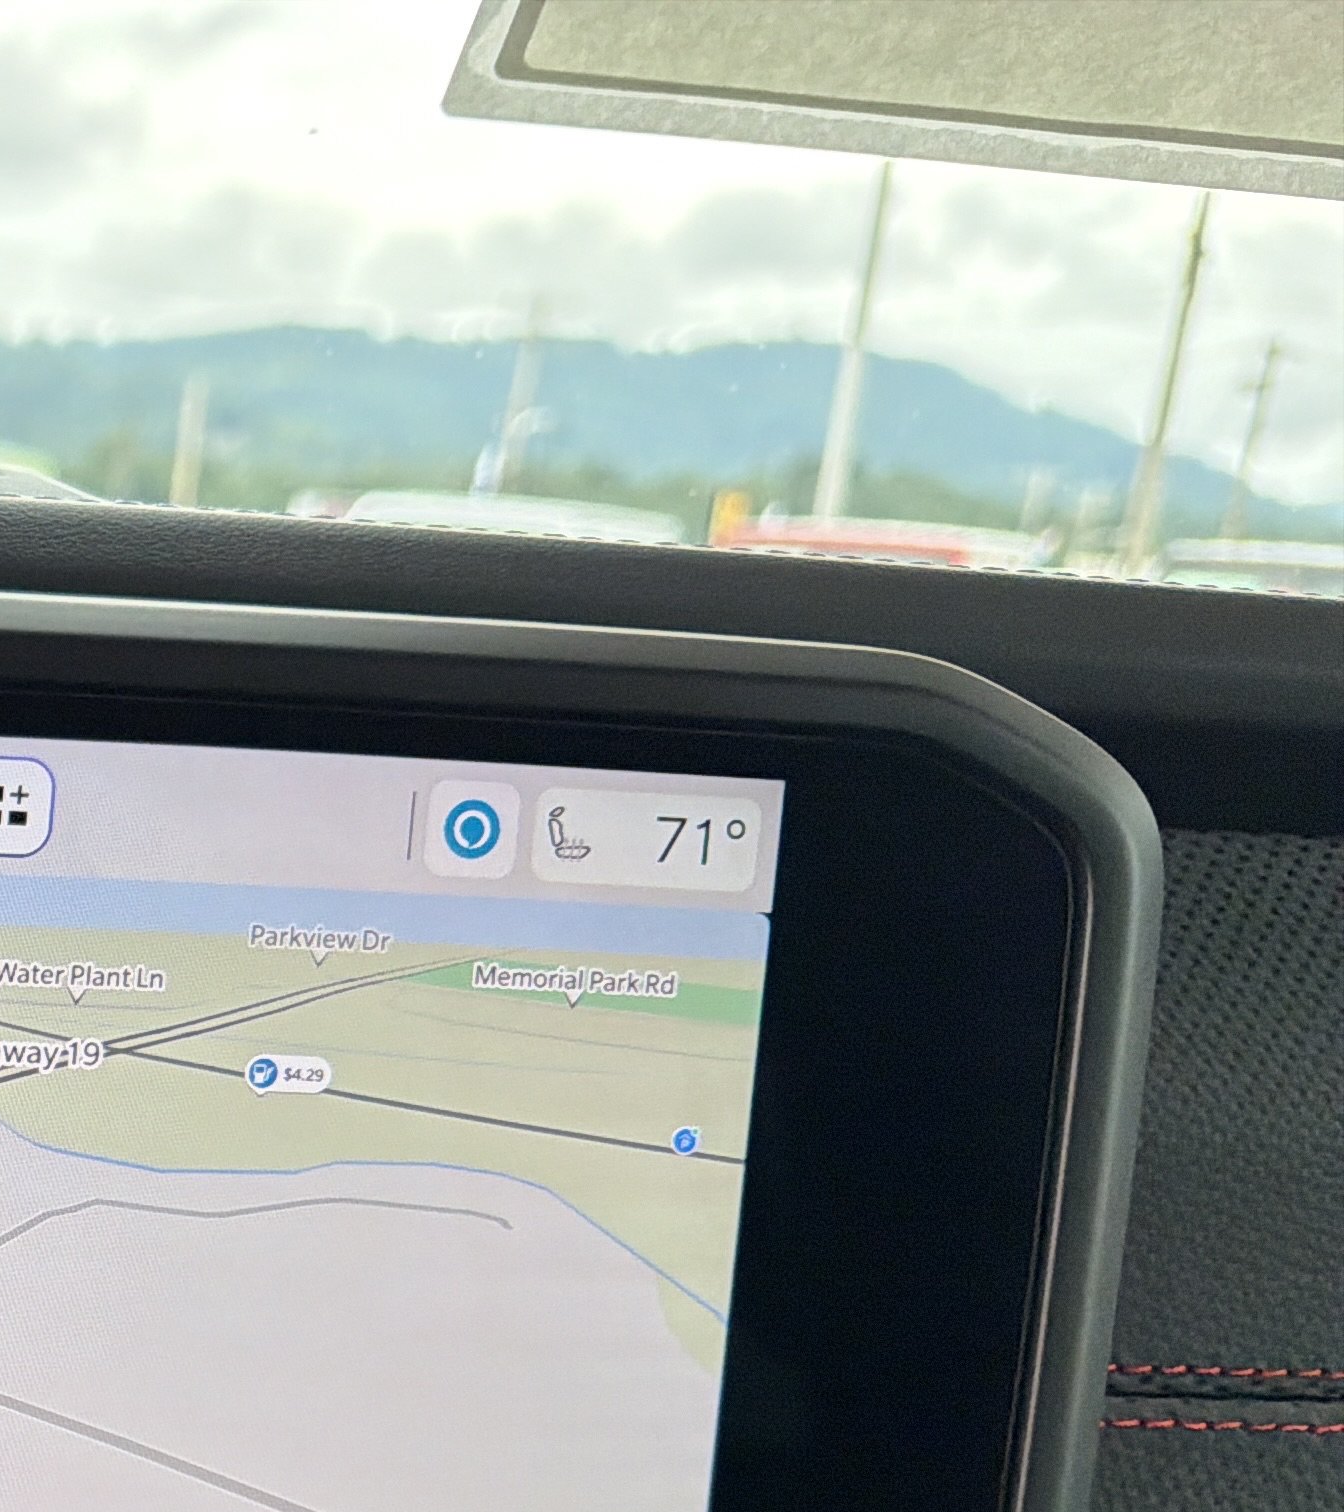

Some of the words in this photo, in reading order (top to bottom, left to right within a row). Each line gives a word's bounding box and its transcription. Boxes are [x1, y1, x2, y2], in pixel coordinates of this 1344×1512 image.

[653, 815, 747, 868] 71°
[250, 925, 356, 953] Parkview
[361, 930, 390, 954] Dr
[72, 964, 132, 990] Plant
[136, 966, 164, 992] Ln
[474, 965, 584, 993] Memorial
[588, 971, 642, 995] Park
[645, 972, 676, 996] Rd
[67, 1041, 102, 1068] 19
[283, 1065, 324, 1084] $4.29
